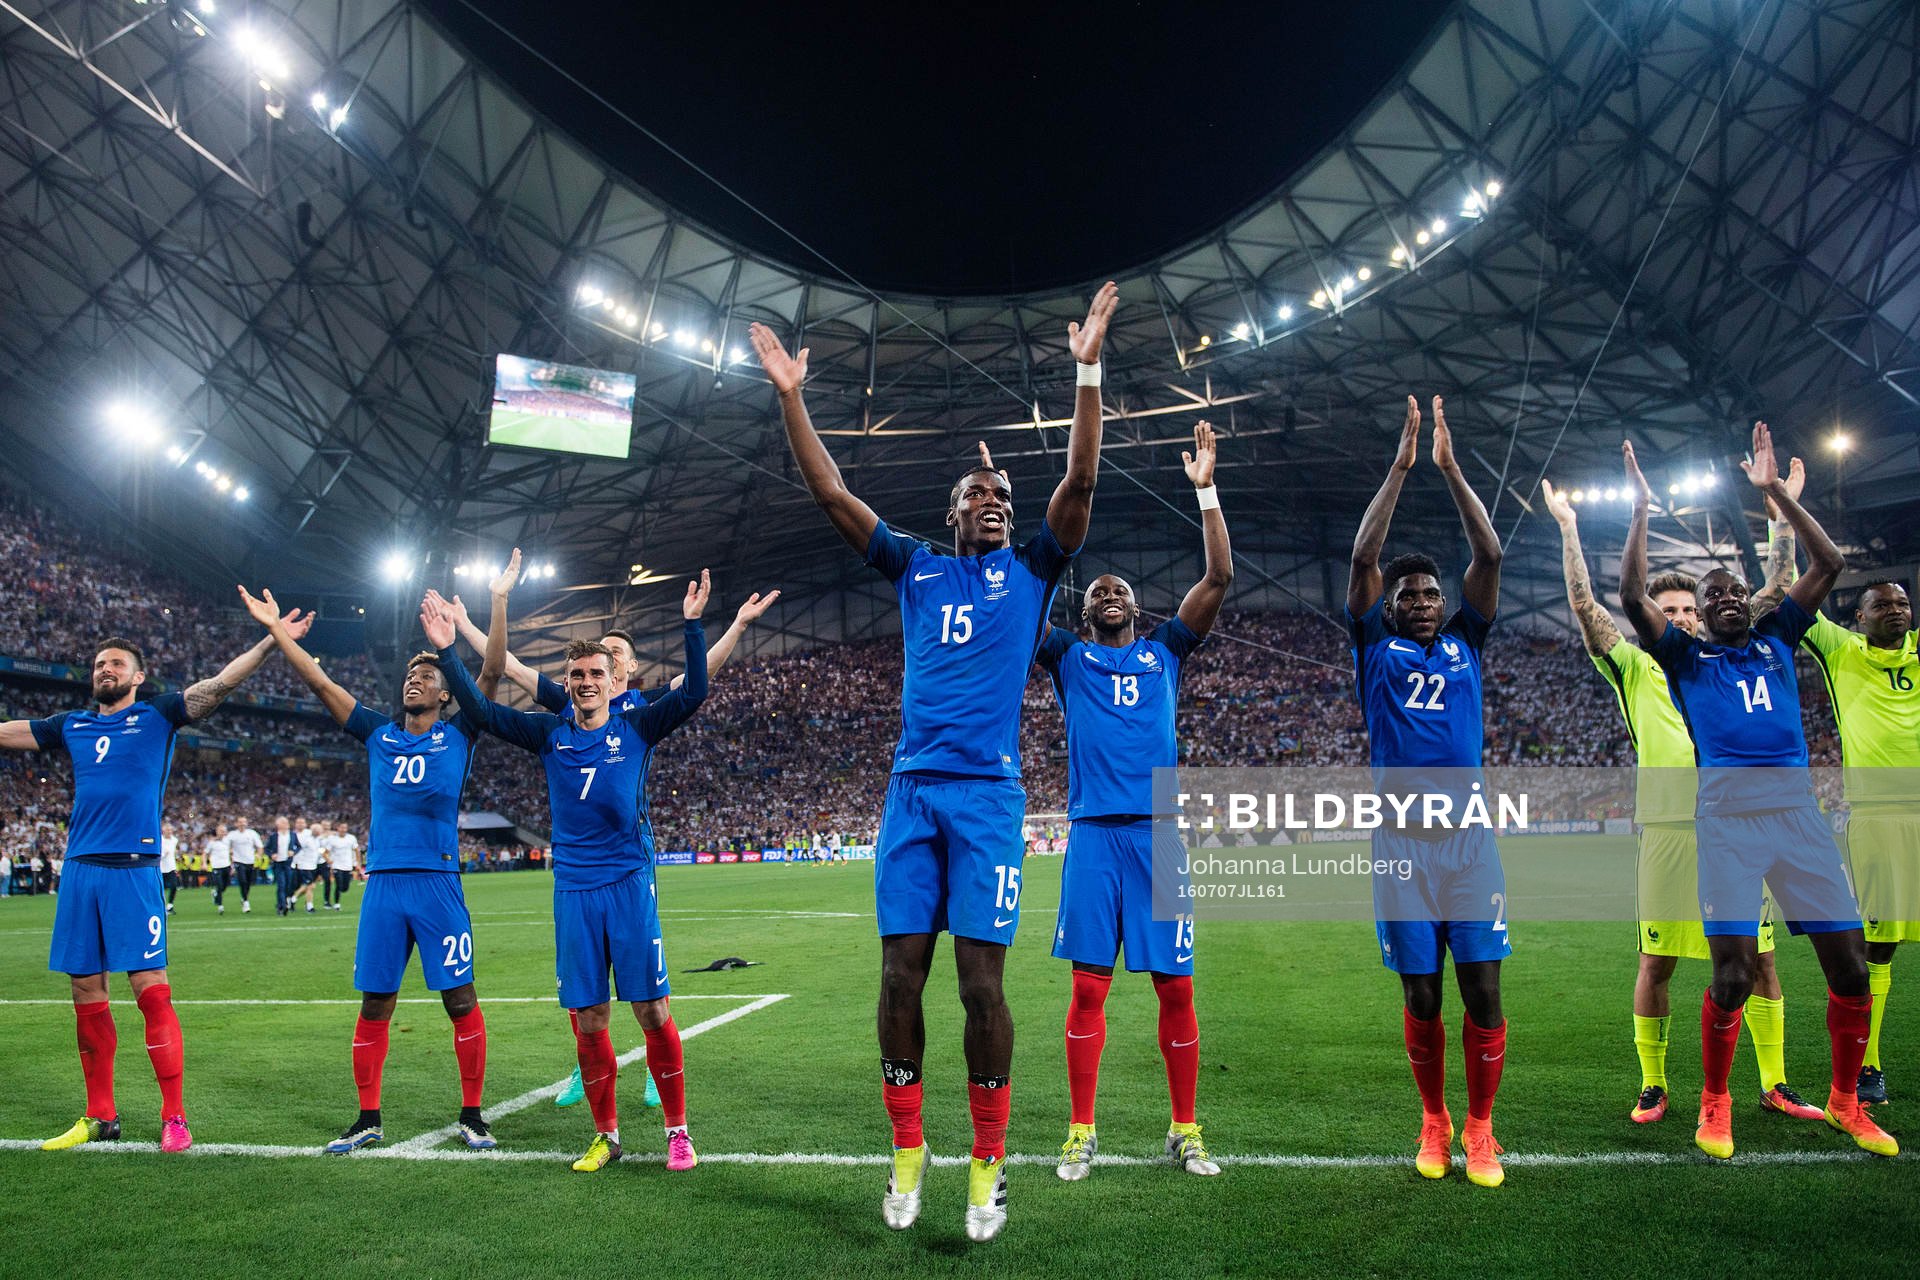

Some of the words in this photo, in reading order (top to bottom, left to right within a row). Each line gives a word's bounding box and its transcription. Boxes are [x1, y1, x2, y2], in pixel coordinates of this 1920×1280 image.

[940, 604, 974, 644] 15
[1111, 674, 1140, 707] 13
[1404, 672, 1446, 711] 22
[1736, 675, 1773, 713] 14
[1883, 666, 1914, 691] 16
[95, 735, 111, 763] 9
[392, 754, 426, 784] 20
[579, 767, 597, 800] 7
[1540, 822, 1570, 833] EURO
[1571, 821, 1599, 832] 2016
[994, 865, 1020, 911] 15
[148, 915, 162, 946] 9
[1175, 913, 1194, 949] 13
[442, 932, 473, 967] 20
[652, 938, 664, 972] 7
